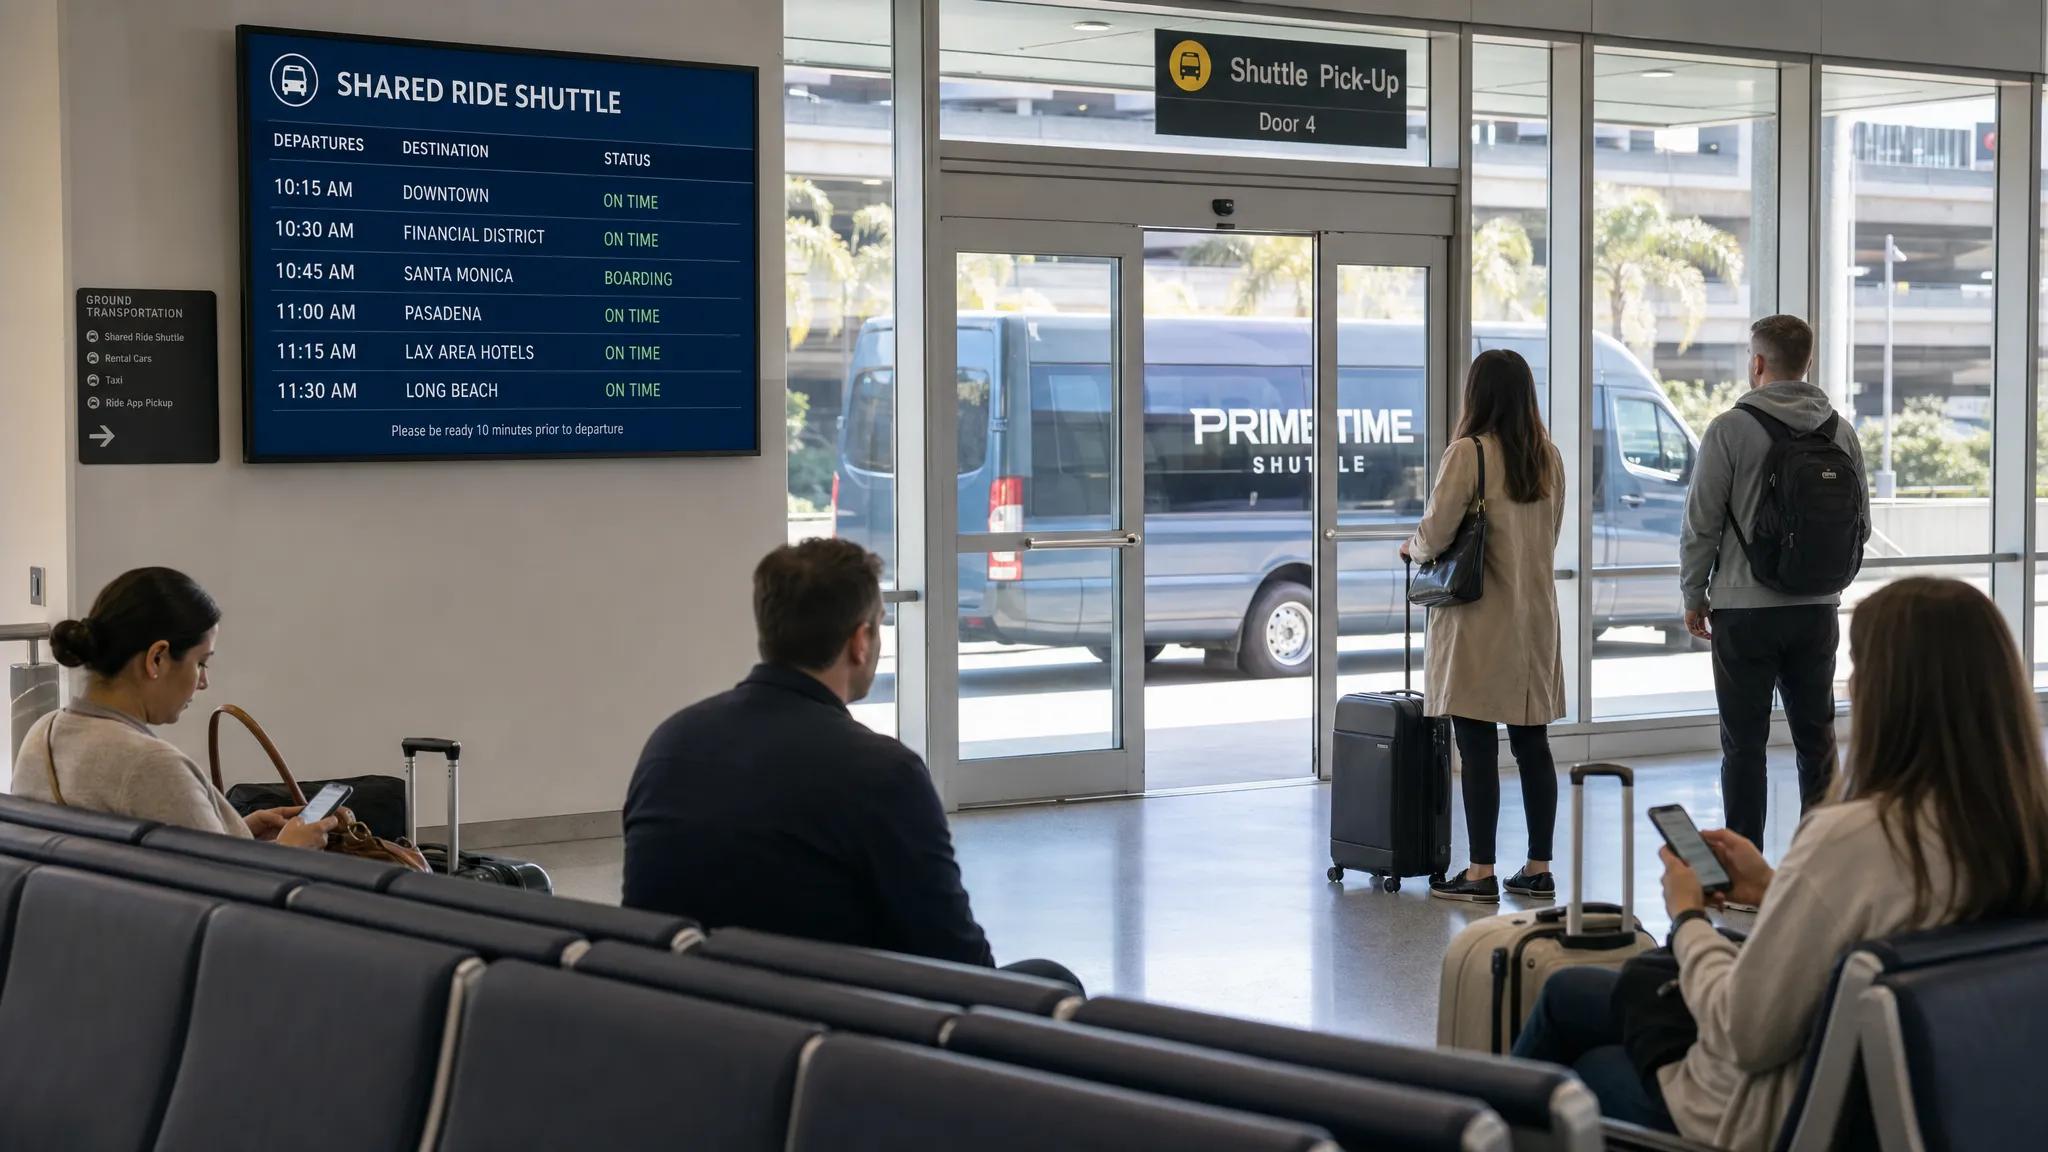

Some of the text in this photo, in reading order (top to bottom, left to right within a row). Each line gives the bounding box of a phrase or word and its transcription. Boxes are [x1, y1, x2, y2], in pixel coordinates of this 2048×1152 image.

[1231, 57, 1399, 98] Shuttle Pick-Up
[338, 72, 621, 113] SHARED RIDE SHUTTLE
[1260, 112, 1316, 133] Door 4
[275, 133, 364, 151] DEPARTURES
[403, 141, 488, 157] DESTINATION
[605, 152, 650, 166] STATUS
[275, 179, 352, 197] 10:15 AM
[404, 185, 488, 202] DOWNTOWN
[604, 194, 658, 209] ON TIME
[276, 220, 353, 238] 10:30 AM
[405, 225, 544, 243] FINANCIAL DISTRICT
[605, 232, 658, 247] ON TIME
[277, 263, 354, 279] 10:45 AM
[405, 266, 513, 282] SANTA MONICA
[605, 271, 672, 286] BOARDING
[87, 295, 131, 305] GROUND
[87, 307, 182, 318] TRANSPORTATION
[277, 303, 355, 319] 11:00 AM
[406, 306, 481, 320] PASADENA
[605, 308, 659, 323] ON TIME
[105, 332, 184, 341] Shared Ride Shuttle
[105, 354, 131, 362] Rental
[278, 343, 355, 359] 11:15 AM
[406, 344, 534, 359] LAX AREA HOTELS
[606, 346, 660, 360] ON TIME
[106, 376, 122, 384] Taxi
[279, 383, 356, 398] 11:30 AM
[407, 383, 497, 397] LONG BEACH
[606, 383, 660, 397] ON TIME
[106, 398, 173, 408] Ride App Pickup
[392, 423, 623, 438] Please be ready 10 minutes prior to departure
[1337, 409, 1414, 443] TIME
[1253, 456, 1365, 473] SHUTLE
